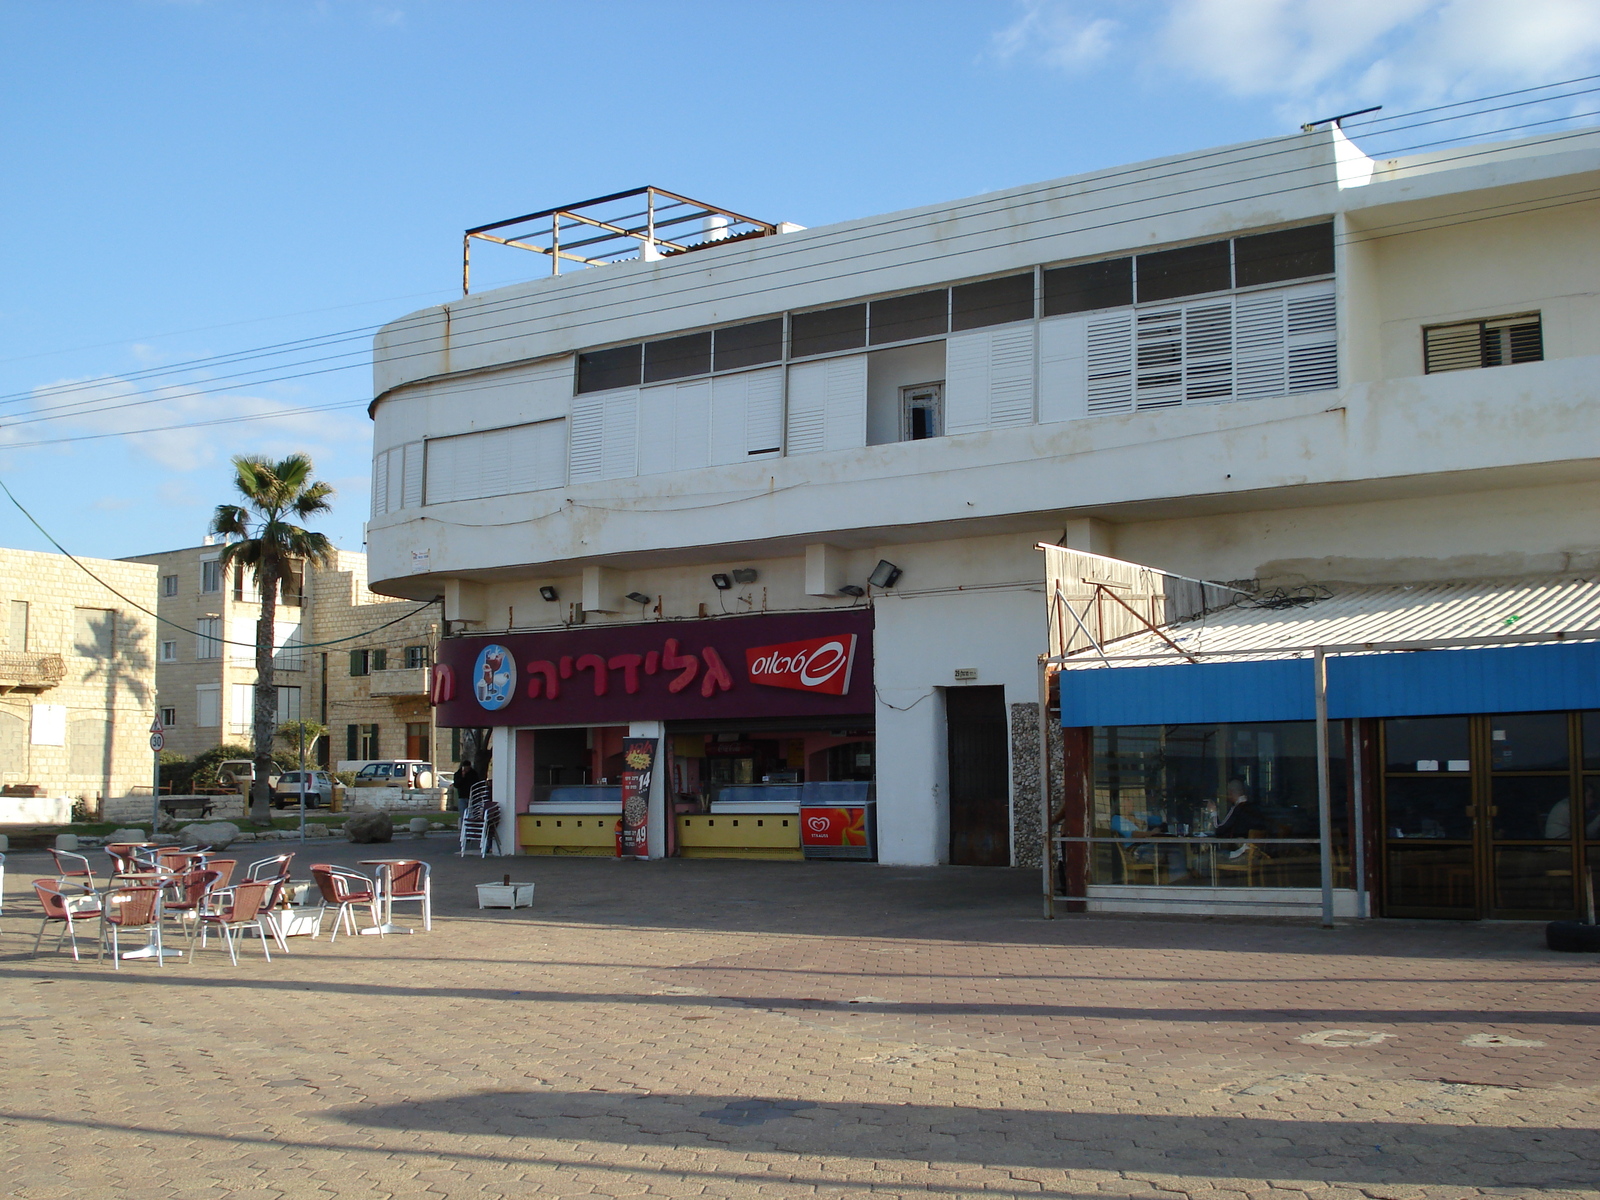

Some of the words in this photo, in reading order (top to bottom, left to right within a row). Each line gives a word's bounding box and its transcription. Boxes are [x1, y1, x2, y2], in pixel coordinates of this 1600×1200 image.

[527, 638, 733, 700] גלידריה
[751, 641, 847, 687] שטראוס
[152, 736, 162, 747] 30
[638, 771, 650, 790] 14
[636, 825, 646, 844] 49
